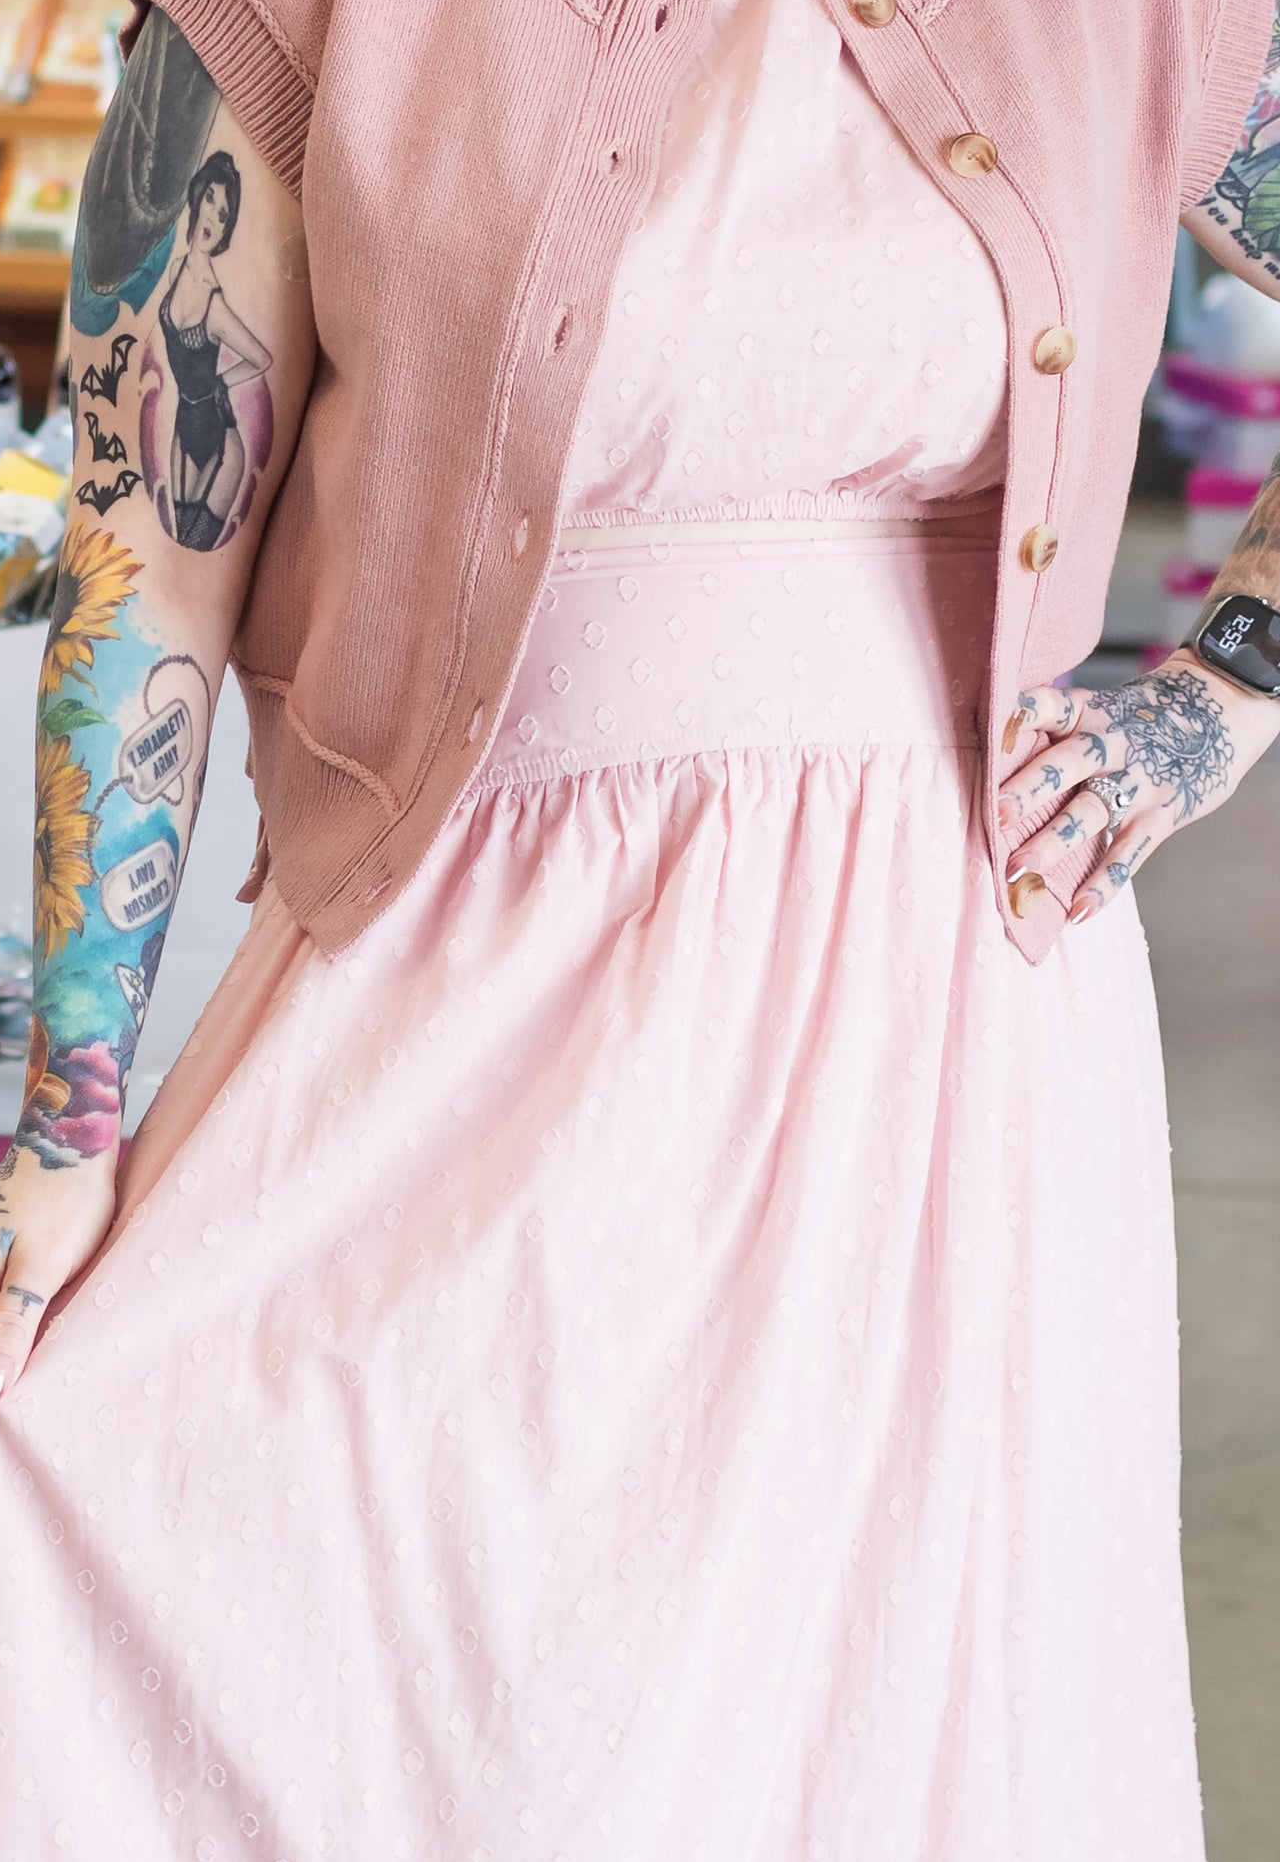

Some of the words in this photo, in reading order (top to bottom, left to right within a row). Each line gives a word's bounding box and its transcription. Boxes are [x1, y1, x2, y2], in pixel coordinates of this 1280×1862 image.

[1218, 614, 1255, 653] 12:55
[152, 744, 180, 780] ARMY
[128, 859, 156, 891] NAVY
